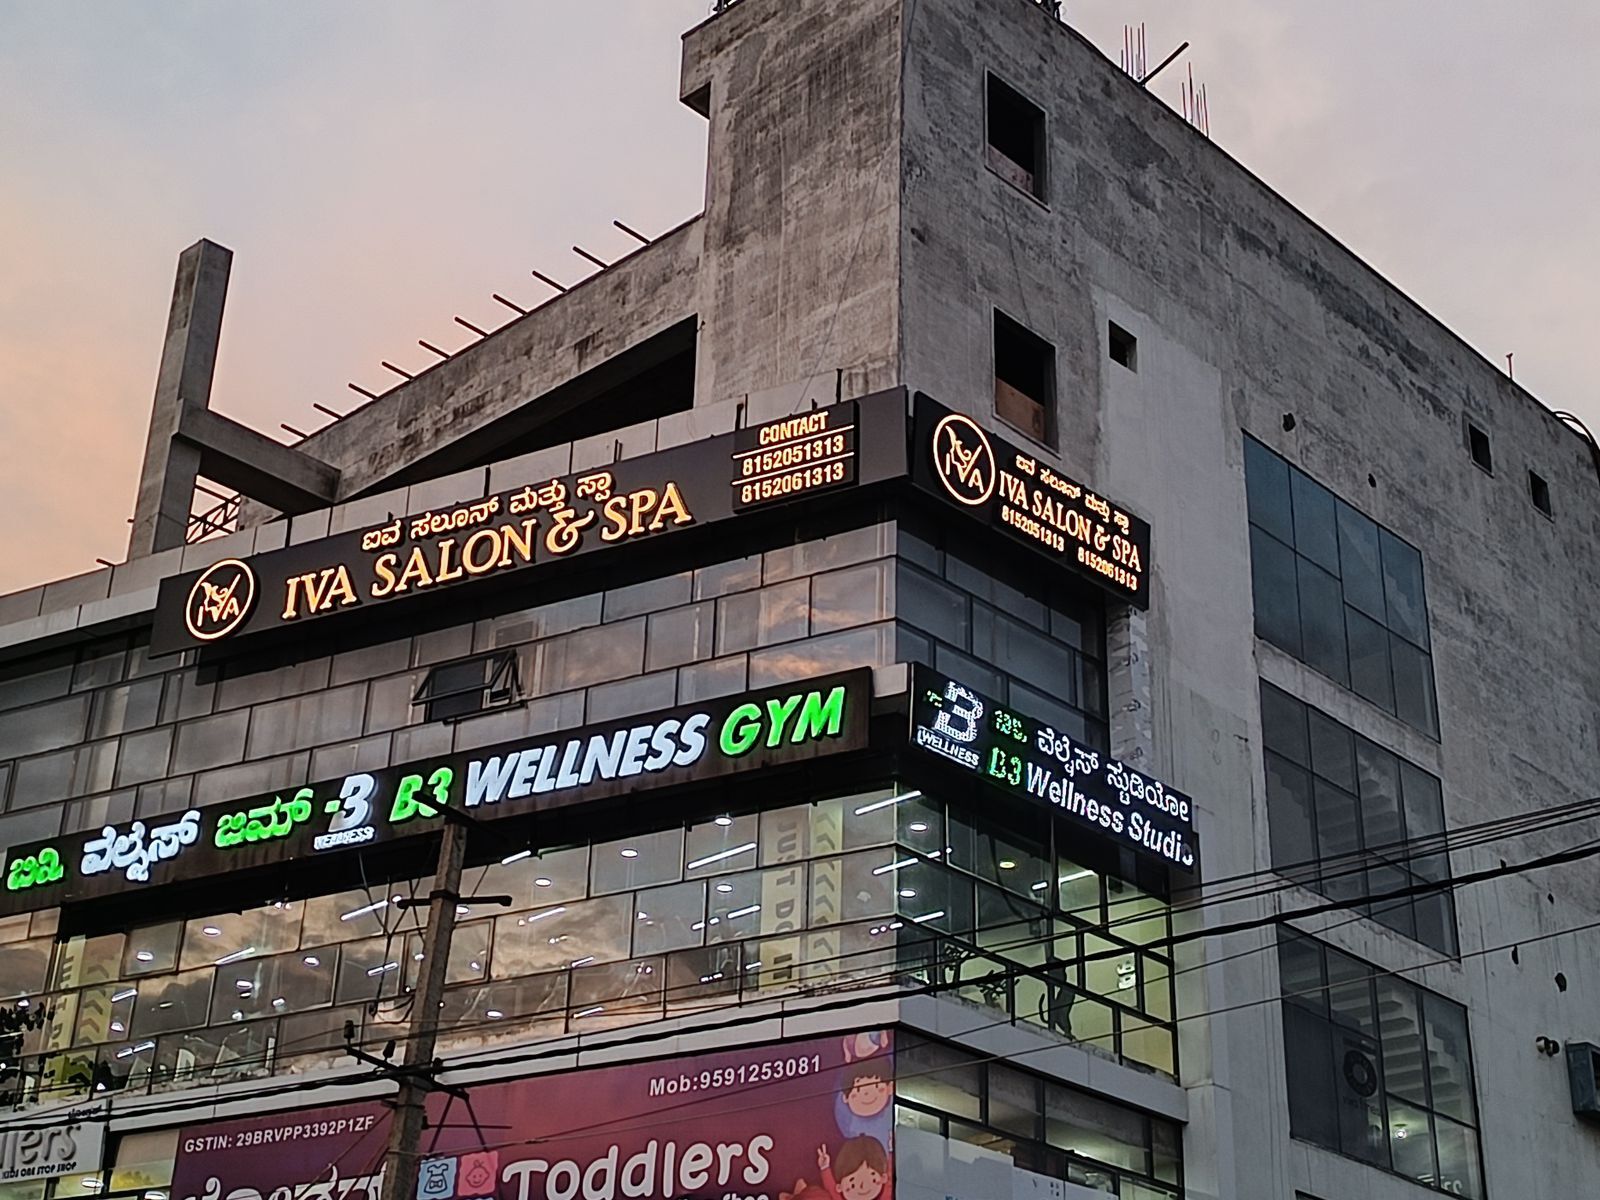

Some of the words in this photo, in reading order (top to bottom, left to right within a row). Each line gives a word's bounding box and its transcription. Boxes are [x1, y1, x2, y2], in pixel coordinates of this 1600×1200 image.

[760, 411, 829, 445] CONTACT
[742, 435, 844, 476] 8152051313
[945, 445, 985, 494] IVA
[741, 462, 844, 503] 8152061313
[362, 520, 401, 550] ಐವ
[410, 496, 499, 539] ಸಲೂನ್
[509, 480, 566, 512] ಮತ್ತು
[576, 471, 613, 501] ಸ್ಪಾ
[999, 470, 1029, 510] IVA
[1032, 490, 1091, 545] SALON
[1094, 524, 1111, 551] &
[1112, 535, 1142, 573] SPA
[282, 565, 357, 619] IVA
[371, 519, 536, 597] SALON
[546, 509, 595, 553] &
[602, 482, 691, 541] SPA
[1002, 505, 1065, 552] 8152051313
[1077, 547, 1138, 591] 8152061313
[196, 574, 241, 627] IVA
[464, 713, 711, 808] WELLNESS
[719, 685, 847, 757] GYM
[921, 730, 980, 766] WELLNESS
[214, 787, 315, 848] ಜಿಮ್
[1026, 762, 1125, 834] Wellness
[1127, 811, 1194, 867] Studio
[649, 1054, 821, 1098] Mob:9591253081
[184, 1136, 233, 1153] GSTIN:
[235, 1115, 375, 1148] 29BRVPP3392P1ZF
[37, 1165, 55, 1175] STOP
[57, 1161, 77, 1172] SHOP
[502, 1135, 774, 1200] Toddlers
